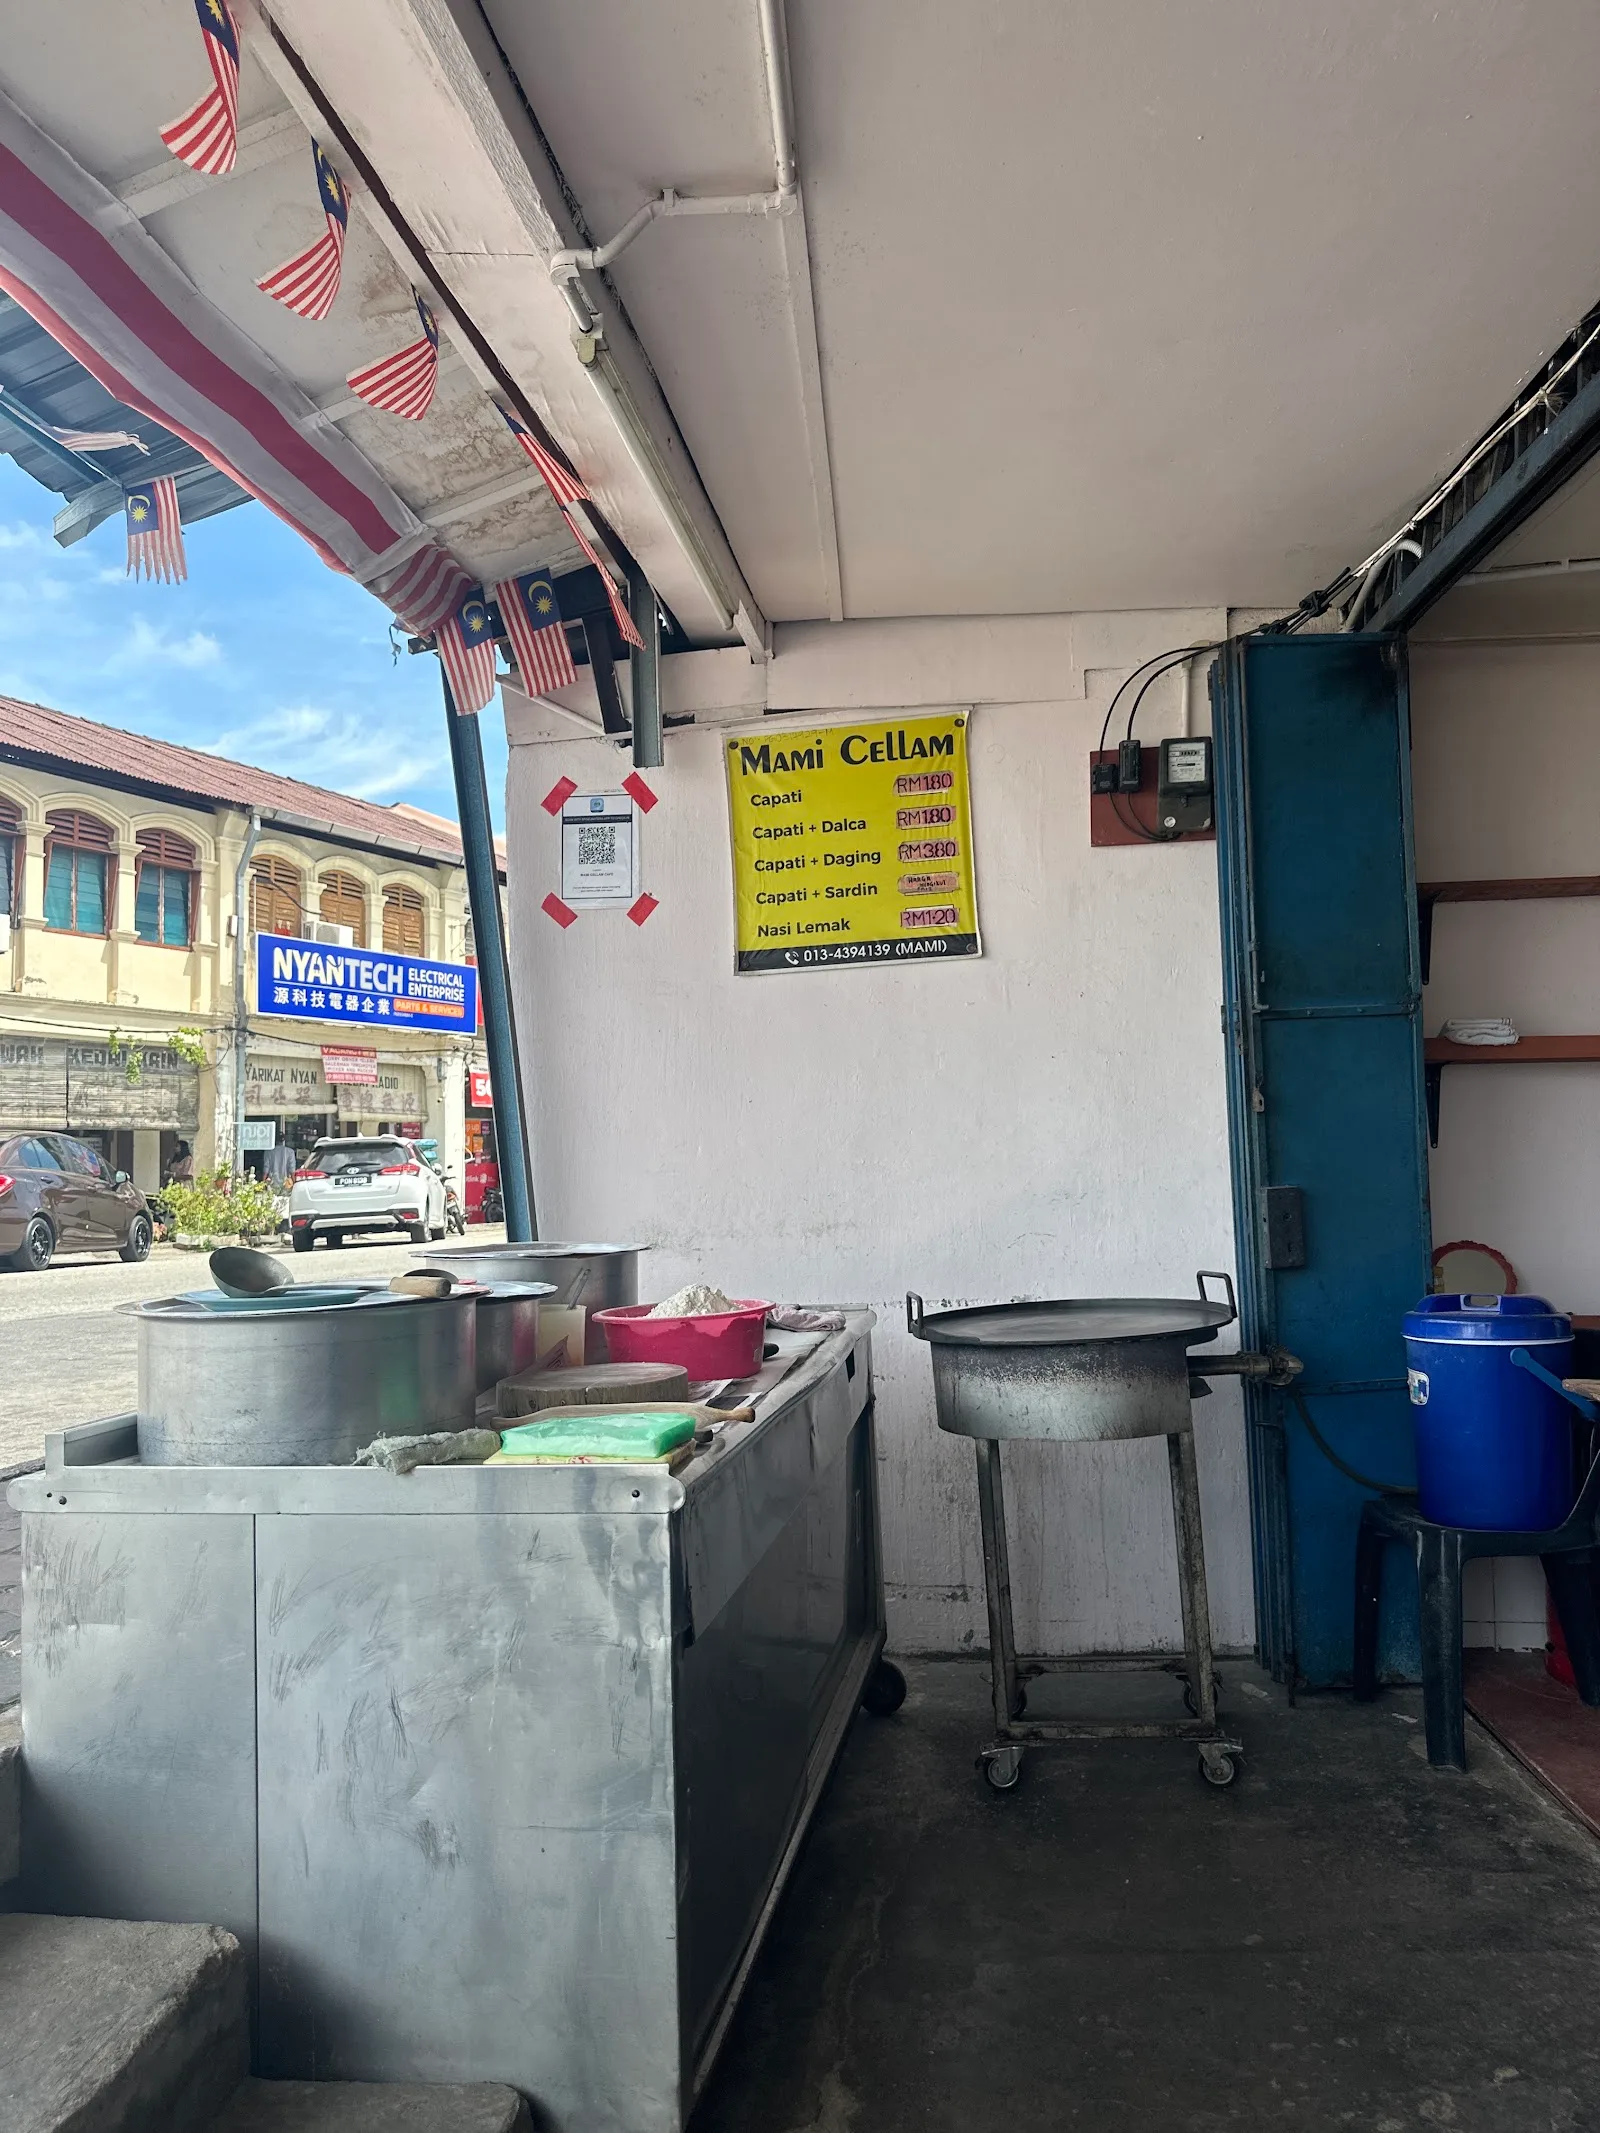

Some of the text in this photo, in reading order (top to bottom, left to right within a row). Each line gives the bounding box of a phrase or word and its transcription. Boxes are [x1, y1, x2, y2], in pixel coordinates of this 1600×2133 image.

[751, 790, 802, 808] Capati
[752, 818, 867, 841] Capati + Dalca
[754, 850, 881, 873] Capati + Daging
[756, 883, 878, 906] Capati + Sardin
[757, 918, 850, 938] Nasi Lemak
[804, 939, 947, 962] 013-4394139 (MAMI)
[273, 947, 403, 994] NYANTECH
[408, 967, 465, 988] ELECTRICAL
[273, 986, 391, 1016] 源科技電器企業
[408, 982, 465, 1002] ENTERPRISE
[245, 1067, 284, 1082] YARIKAT
[291, 1068, 317, 1084] NYAN
